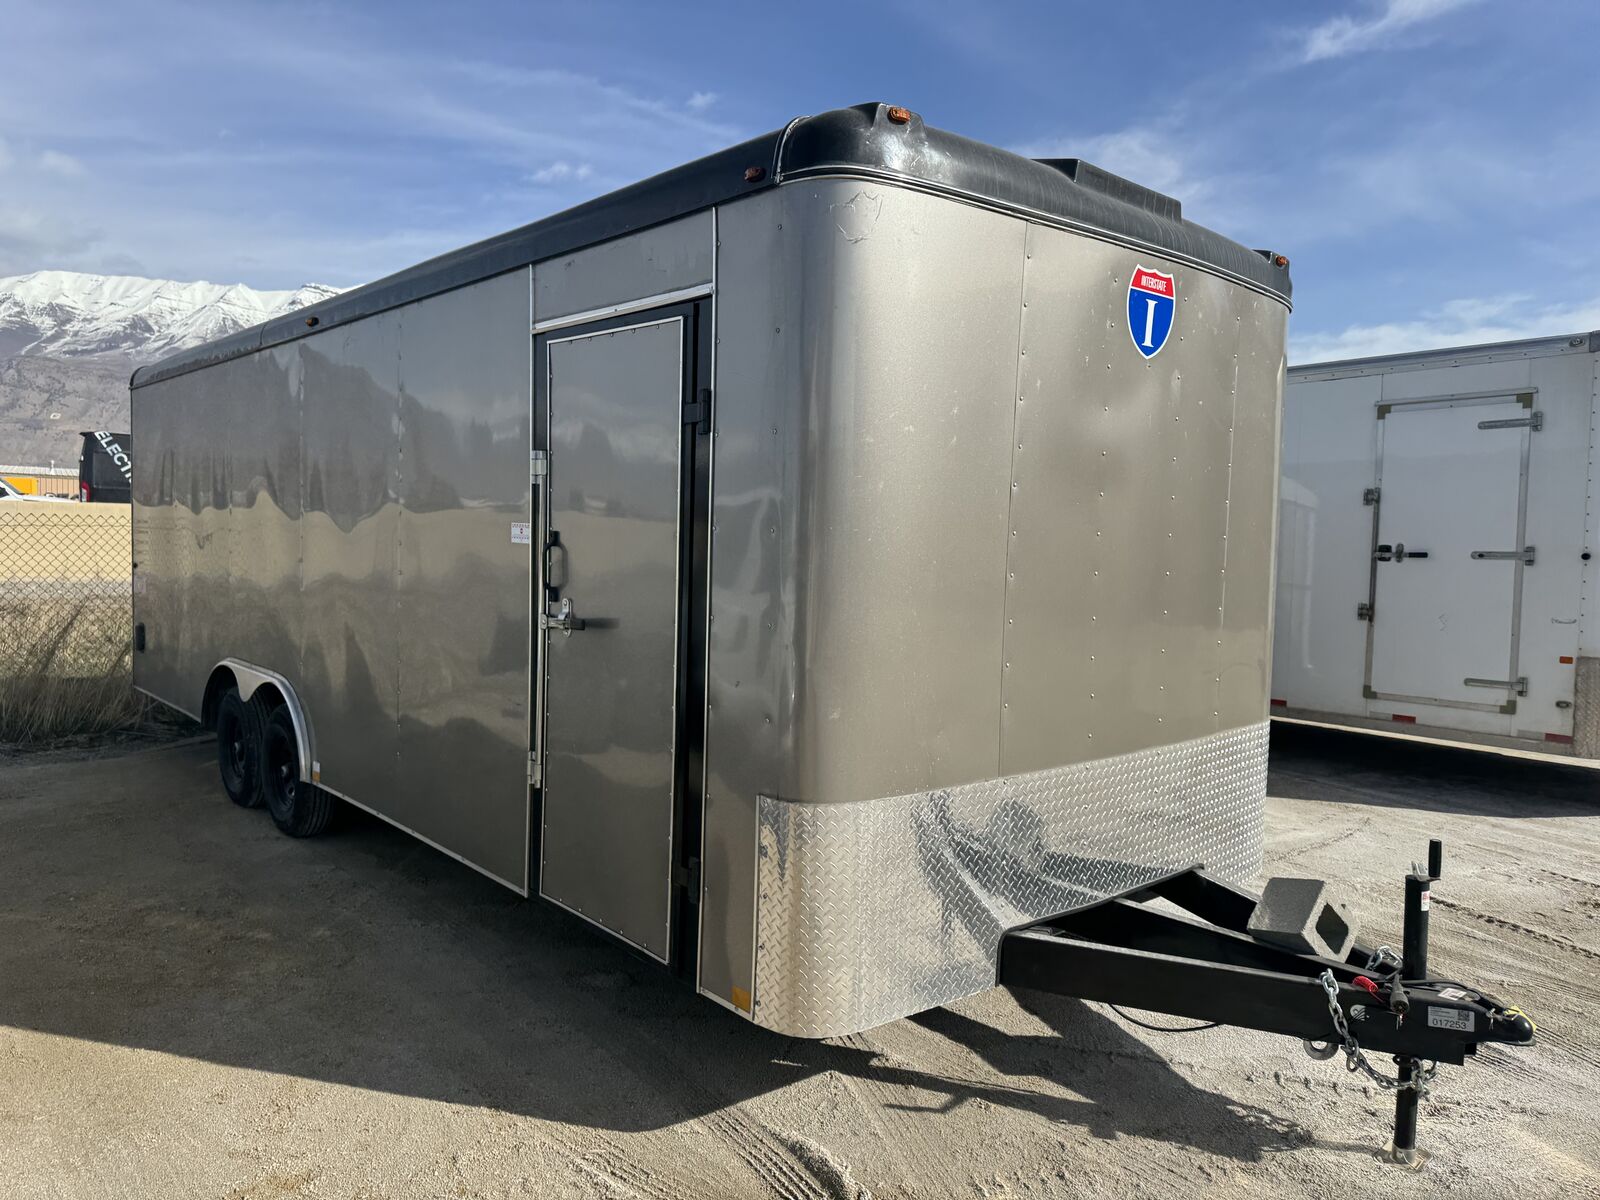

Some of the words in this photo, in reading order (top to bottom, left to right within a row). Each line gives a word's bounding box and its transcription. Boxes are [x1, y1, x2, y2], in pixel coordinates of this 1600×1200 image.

[1141, 275, 1167, 292] INTERSTATE
[1141, 298, 1159, 348] I
[1432, 1018, 1467, 1030] 017253
